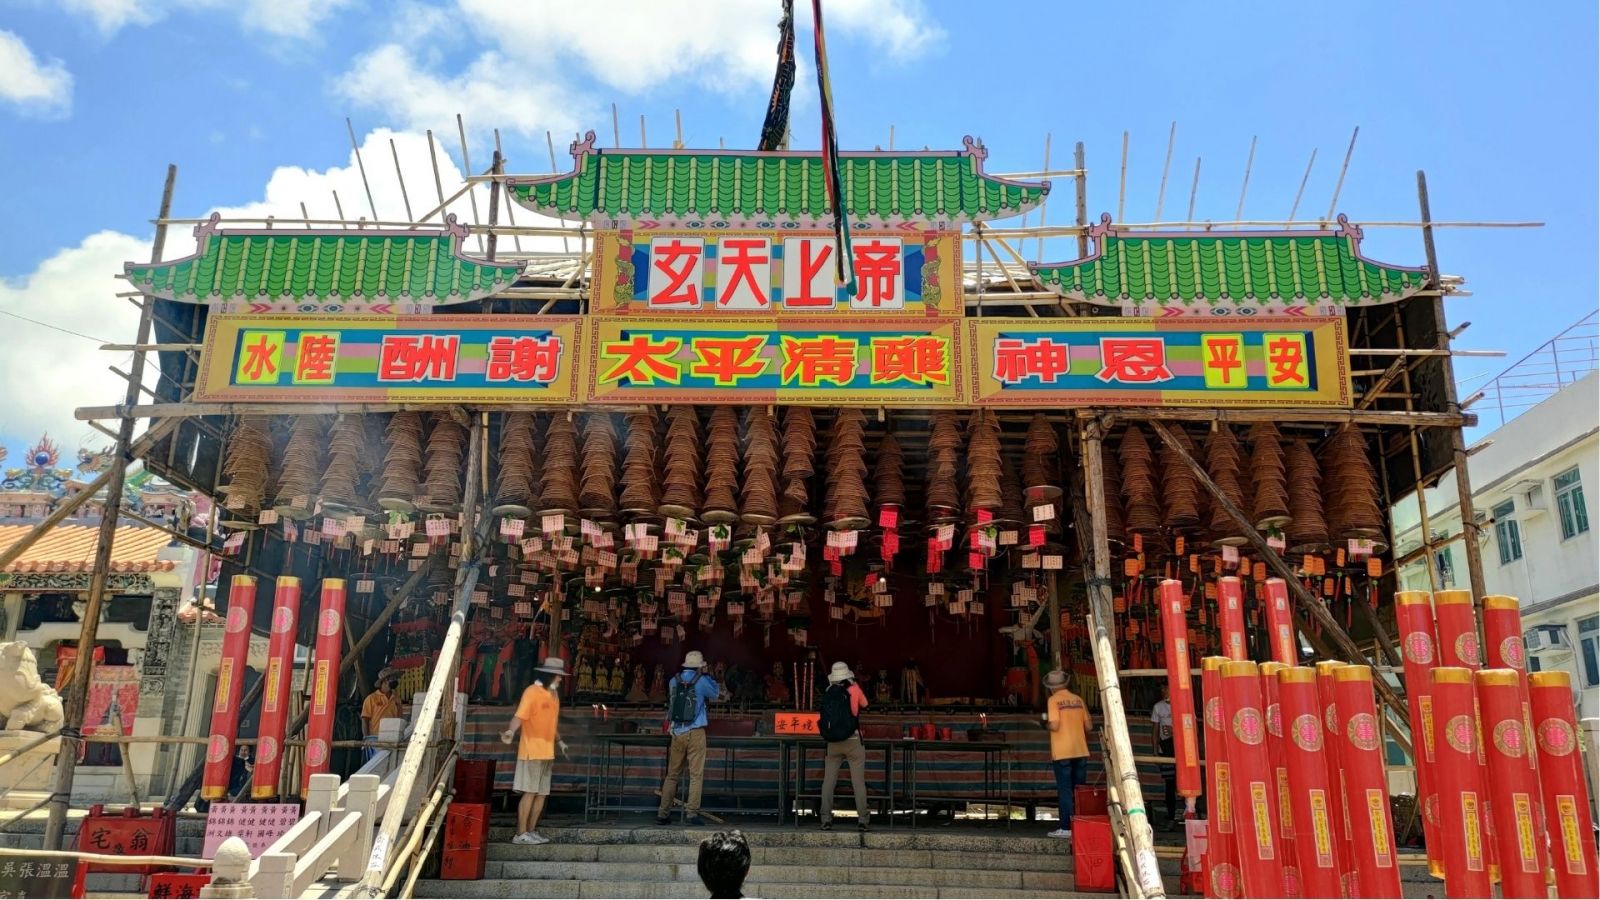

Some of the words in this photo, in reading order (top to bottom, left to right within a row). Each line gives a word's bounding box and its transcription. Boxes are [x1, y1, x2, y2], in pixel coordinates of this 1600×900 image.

[653, 238, 902, 309] 玄天上帝
[242, 335, 337, 382] 水陸
[601, 333, 950, 387] 太平清醮
[1206, 336, 1305, 386] 平安
